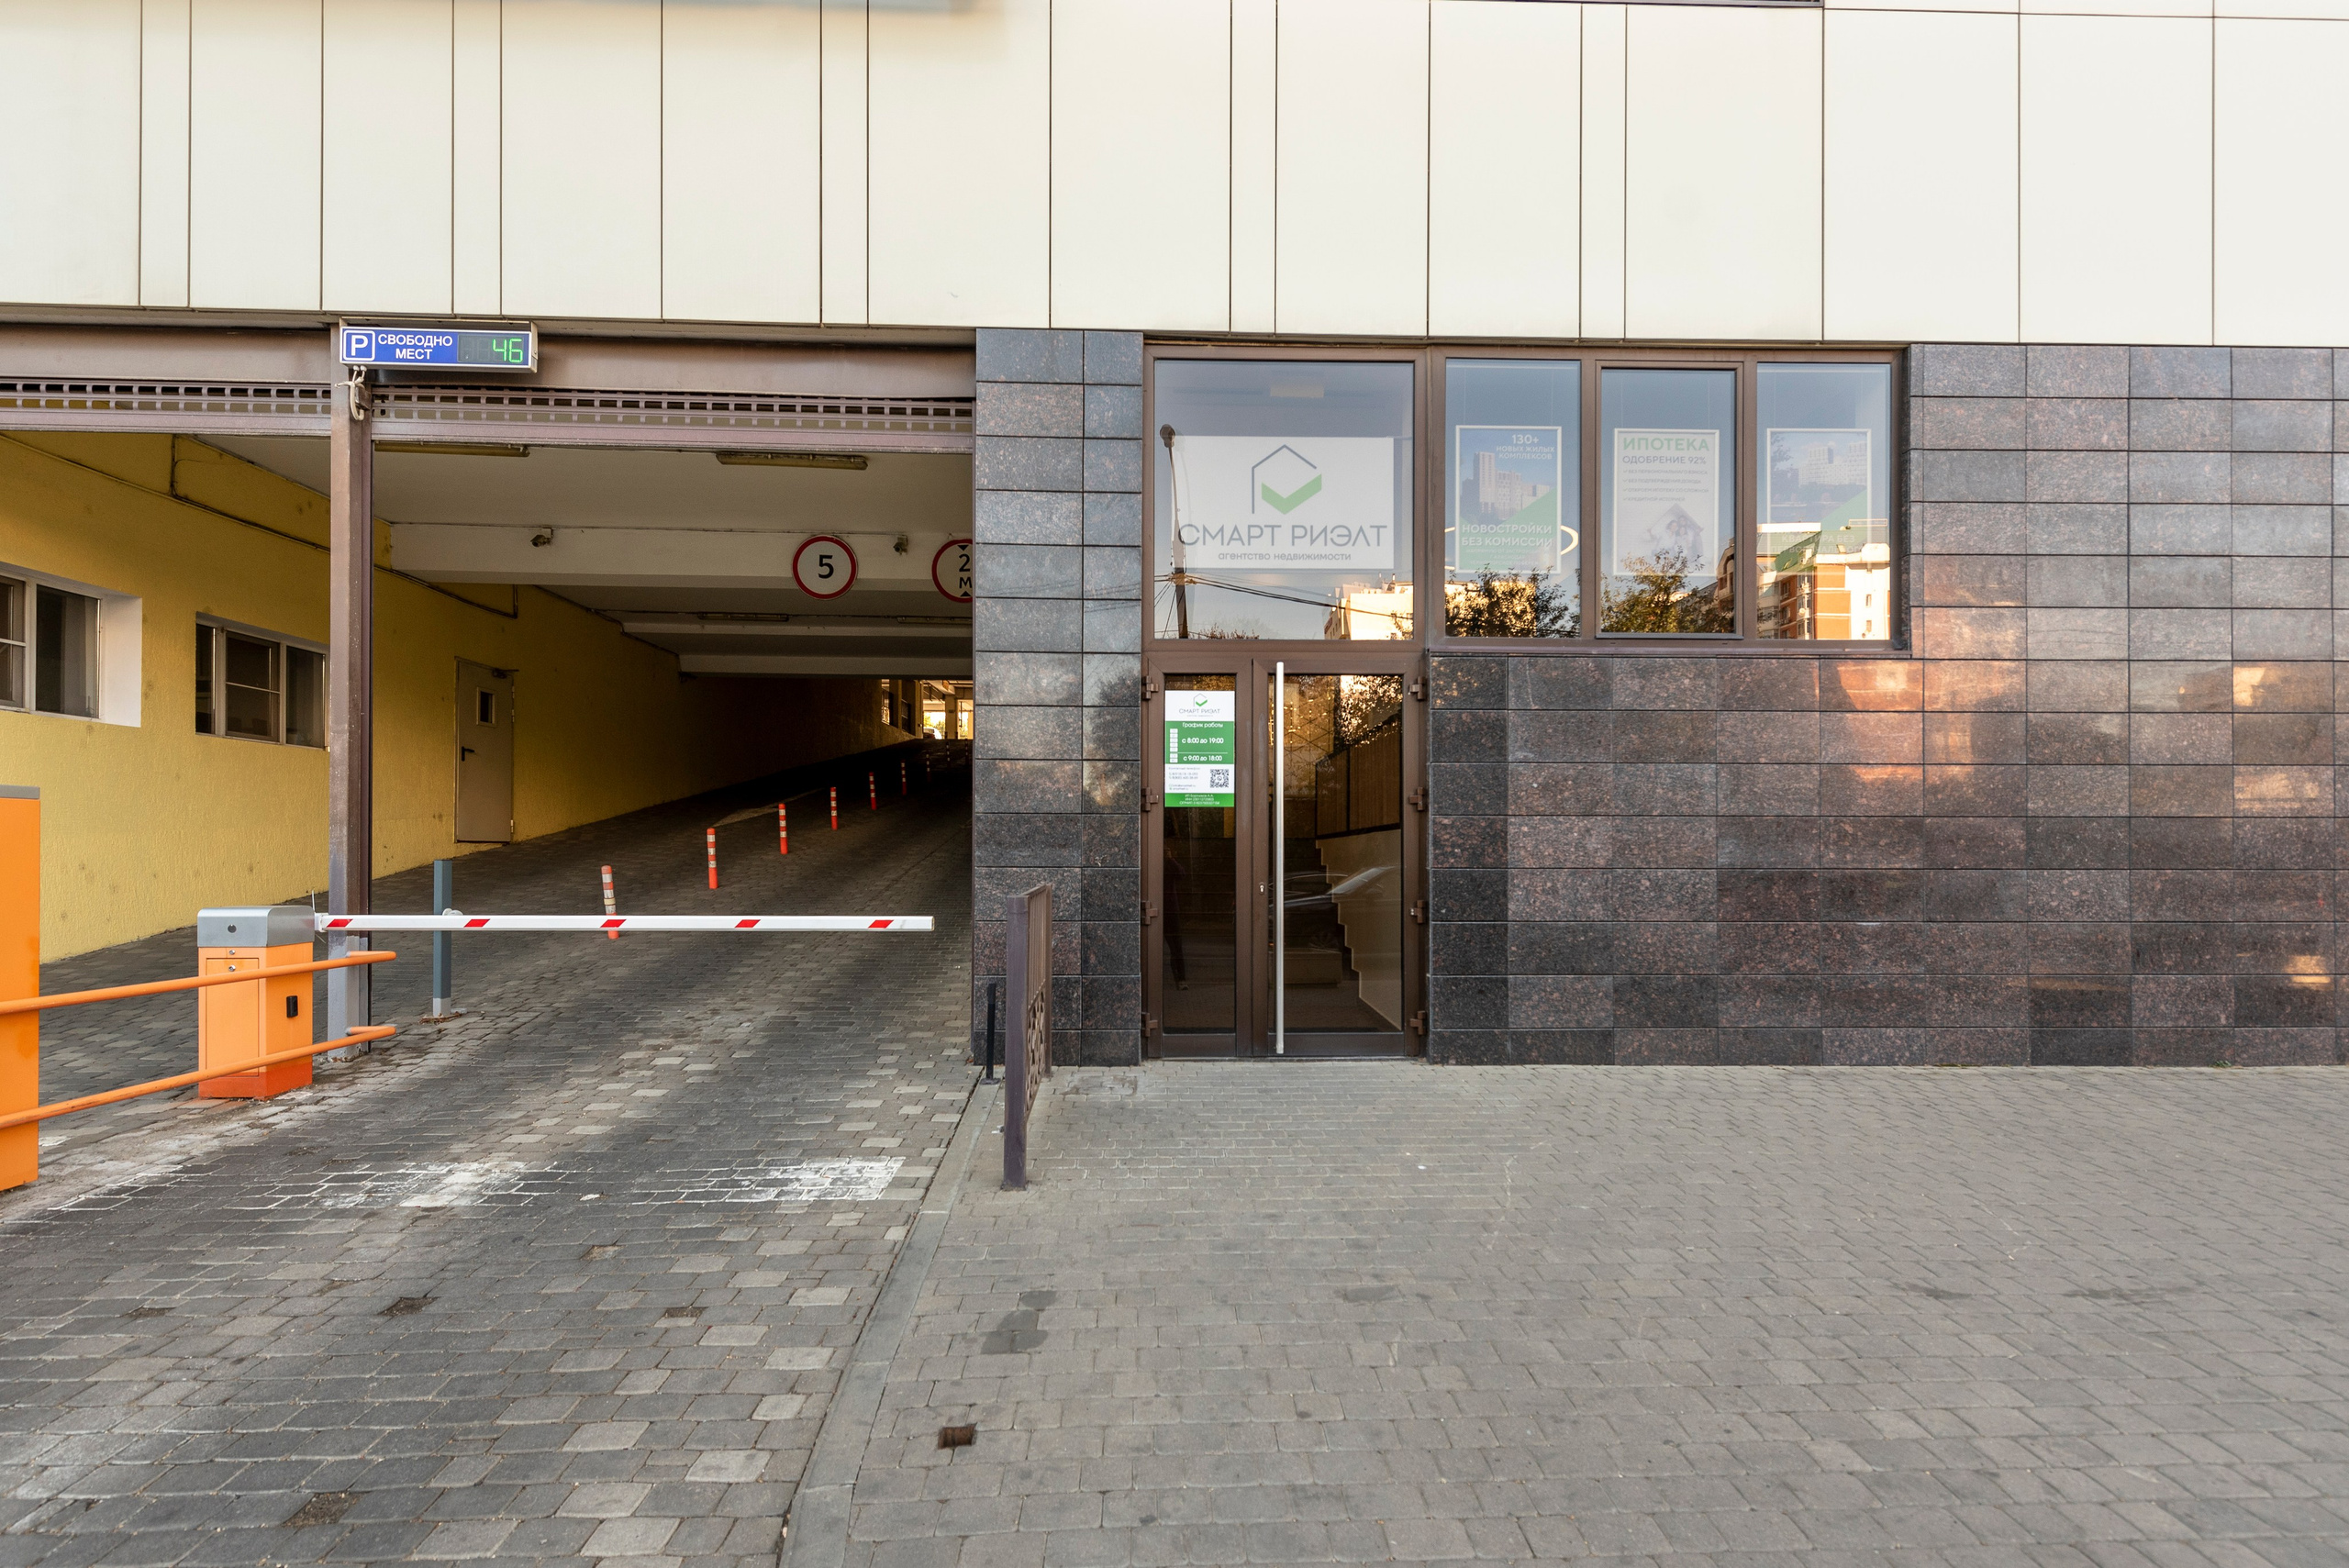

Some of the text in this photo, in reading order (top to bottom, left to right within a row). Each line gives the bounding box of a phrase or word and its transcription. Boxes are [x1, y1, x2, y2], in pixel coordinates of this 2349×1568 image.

[377, 333, 453, 349] СВОБОДНО
[395, 349, 433, 361] МЕСТ
[492, 337, 524, 363] 46
[1511, 434, 1539, 445] 130+
[1622, 437, 1710, 451] ИПОТЕКА
[1496, 445, 1555, 454] НОВЫХ ЖИЛЫХ
[1498, 452, 1553, 461] КОМПЛЕКСОВ
[1622, 455, 1707, 465] ОДОБРЕНИЕ 92%
[1462, 522, 1553, 535] НОВОСТРОЙКИ
[1178, 523, 1388, 548] СМАРТ РИЭЛТ
[1837, 534, 1856, 543] БЕЗ
[1462, 537, 1553, 548] БЕЗ КОМИССИИ
[1218, 552, 1352, 562] агентство недвижимости
[818, 554, 834, 580] 5
